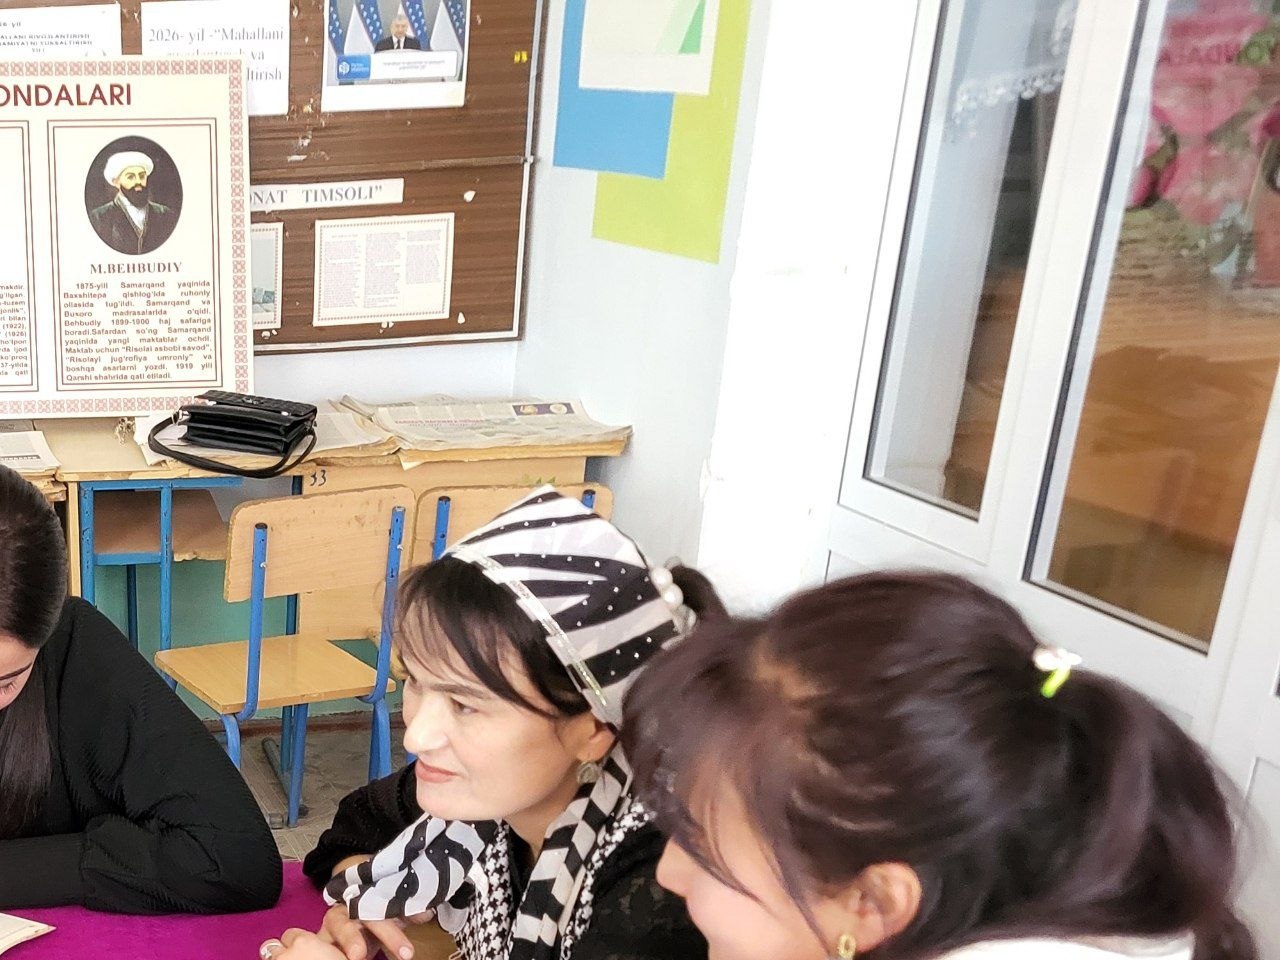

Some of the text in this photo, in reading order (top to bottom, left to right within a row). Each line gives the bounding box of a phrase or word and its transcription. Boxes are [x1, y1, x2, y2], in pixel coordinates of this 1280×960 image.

[149, 28, 184, 42] 2026-
[189, 28, 204, 44] yil
[251, 51, 265, 60] va
[247, 67, 282, 81] ltirish
[250, 185, 382, 205] NAT TIMSOLI”
[90, 261, 182, 275] M.BEHBUDIY
